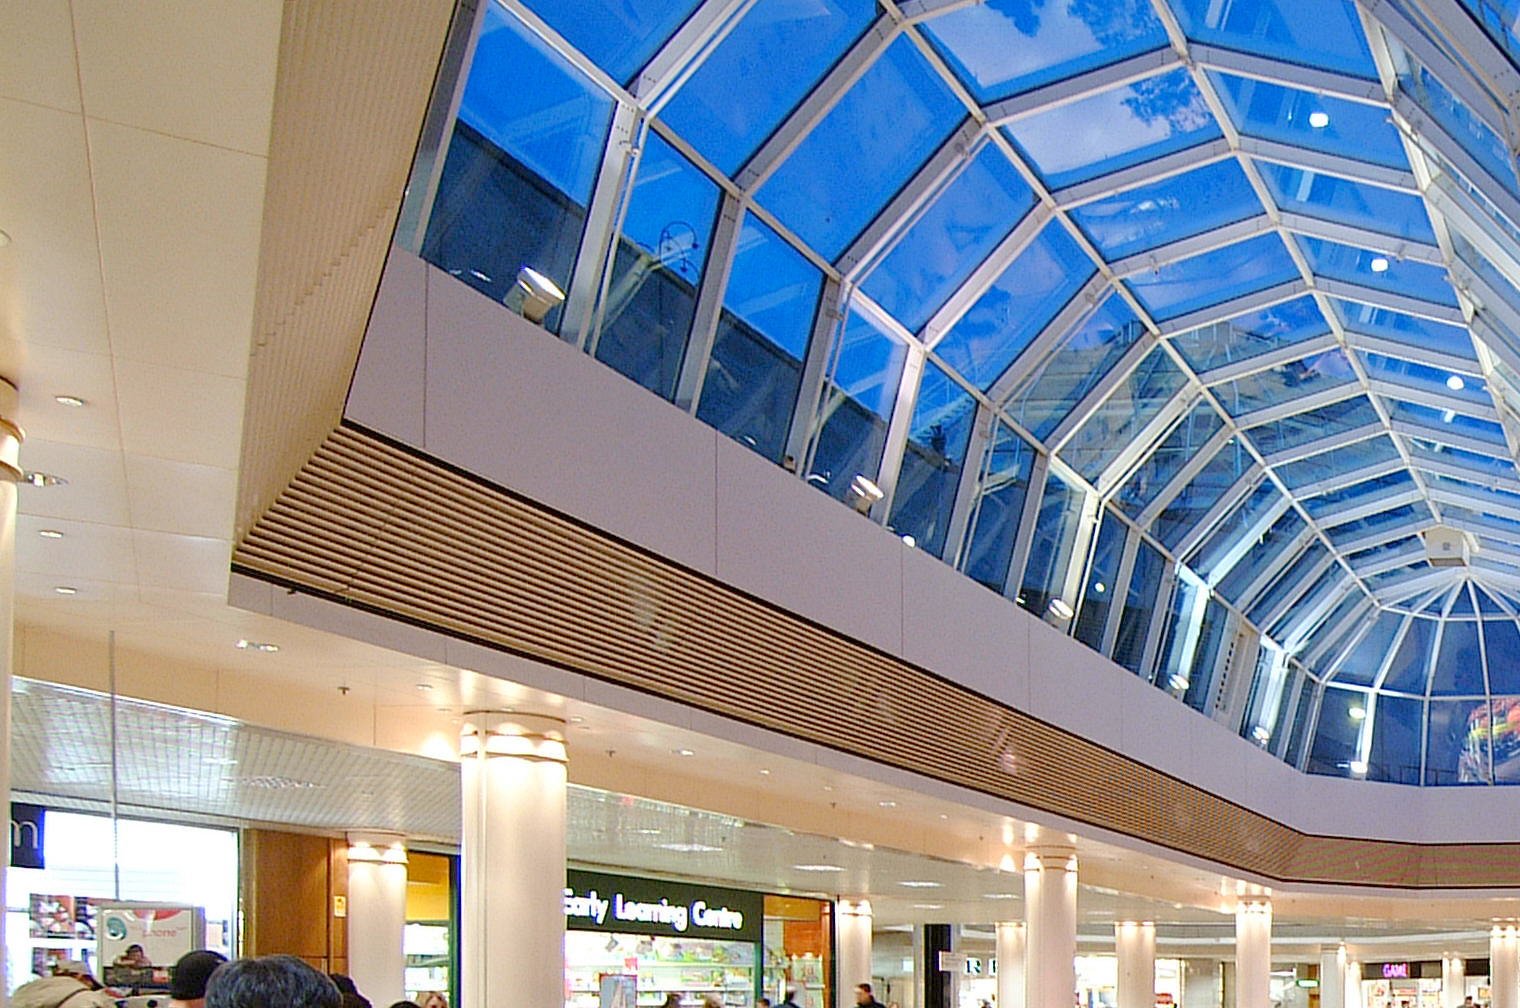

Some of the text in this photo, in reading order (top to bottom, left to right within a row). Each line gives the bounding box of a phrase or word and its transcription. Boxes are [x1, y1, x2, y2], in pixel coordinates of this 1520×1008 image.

[563, 888, 744, 932] Early Learning Centre
[1382, 962, 1408, 978] GAME
